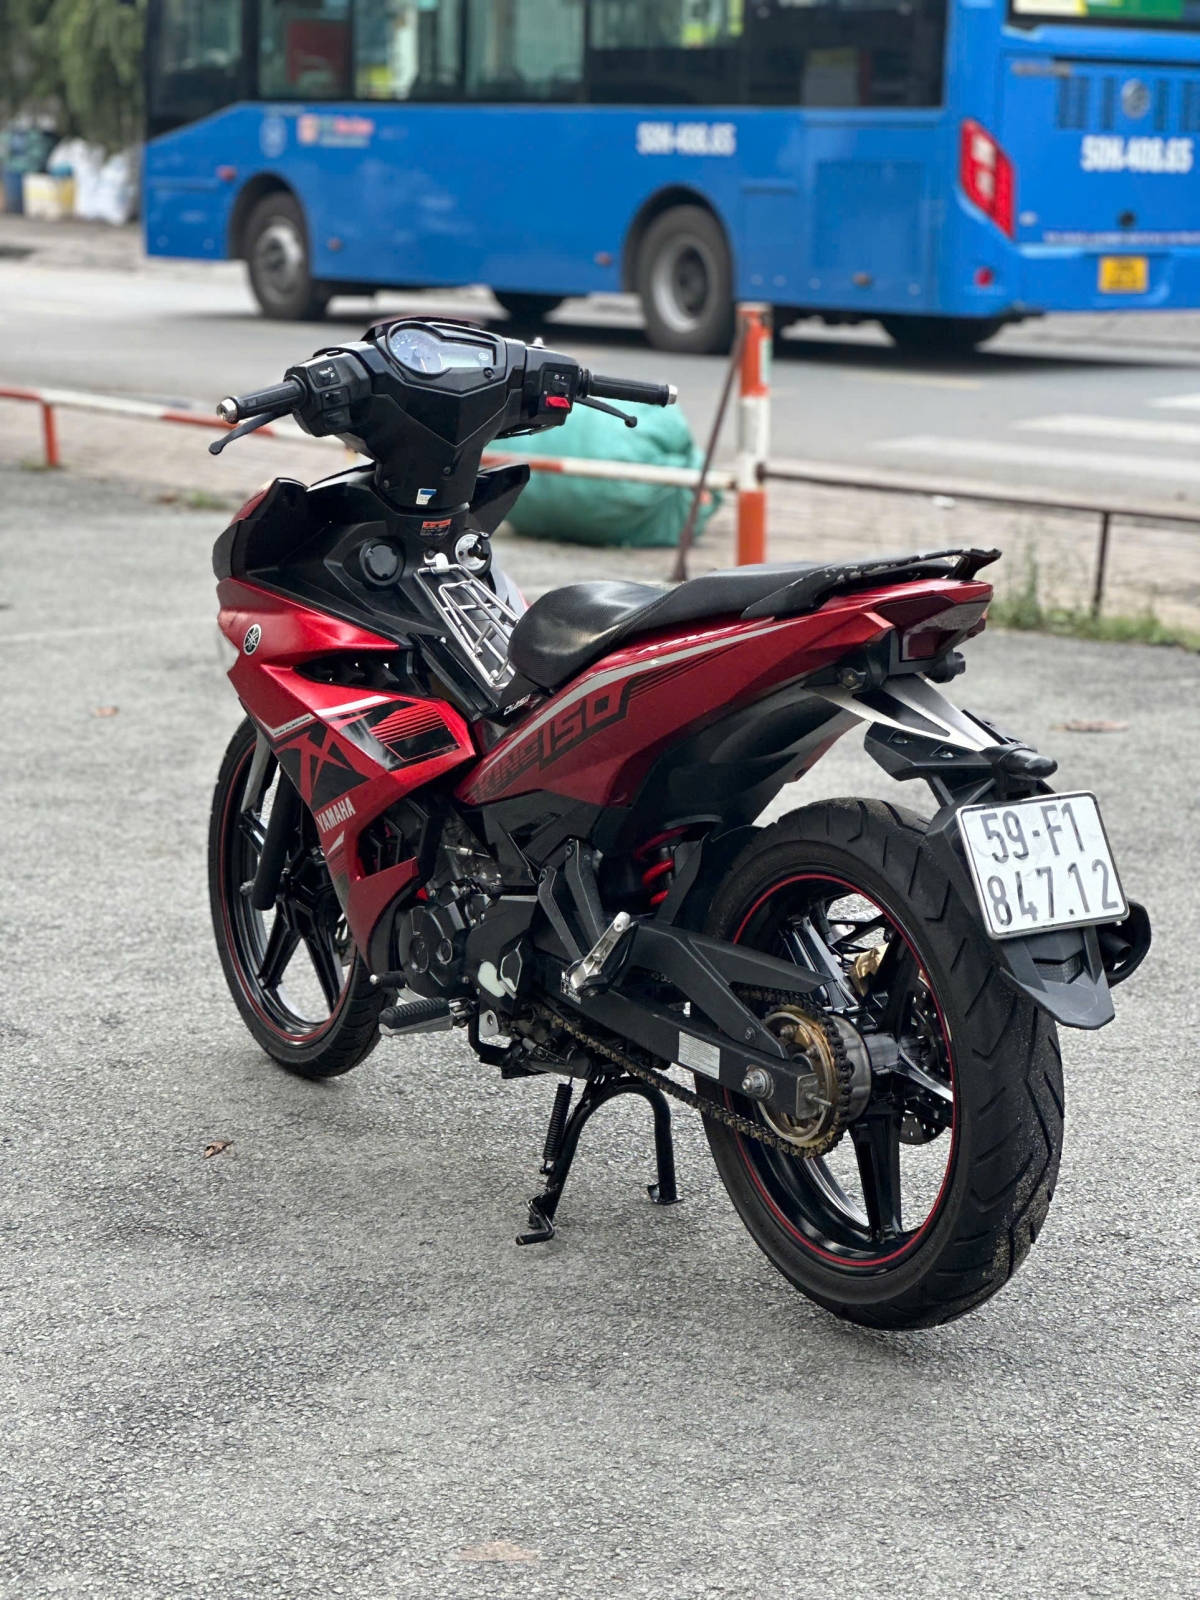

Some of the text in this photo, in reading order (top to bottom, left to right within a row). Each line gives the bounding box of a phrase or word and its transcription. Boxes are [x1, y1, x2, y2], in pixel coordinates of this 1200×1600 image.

[541, 681, 624, 759] 150
[315, 797, 356, 833] YAMAHA
[980, 802, 1085, 864] 59-F1
[987, 859, 1119, 926] 847.12
